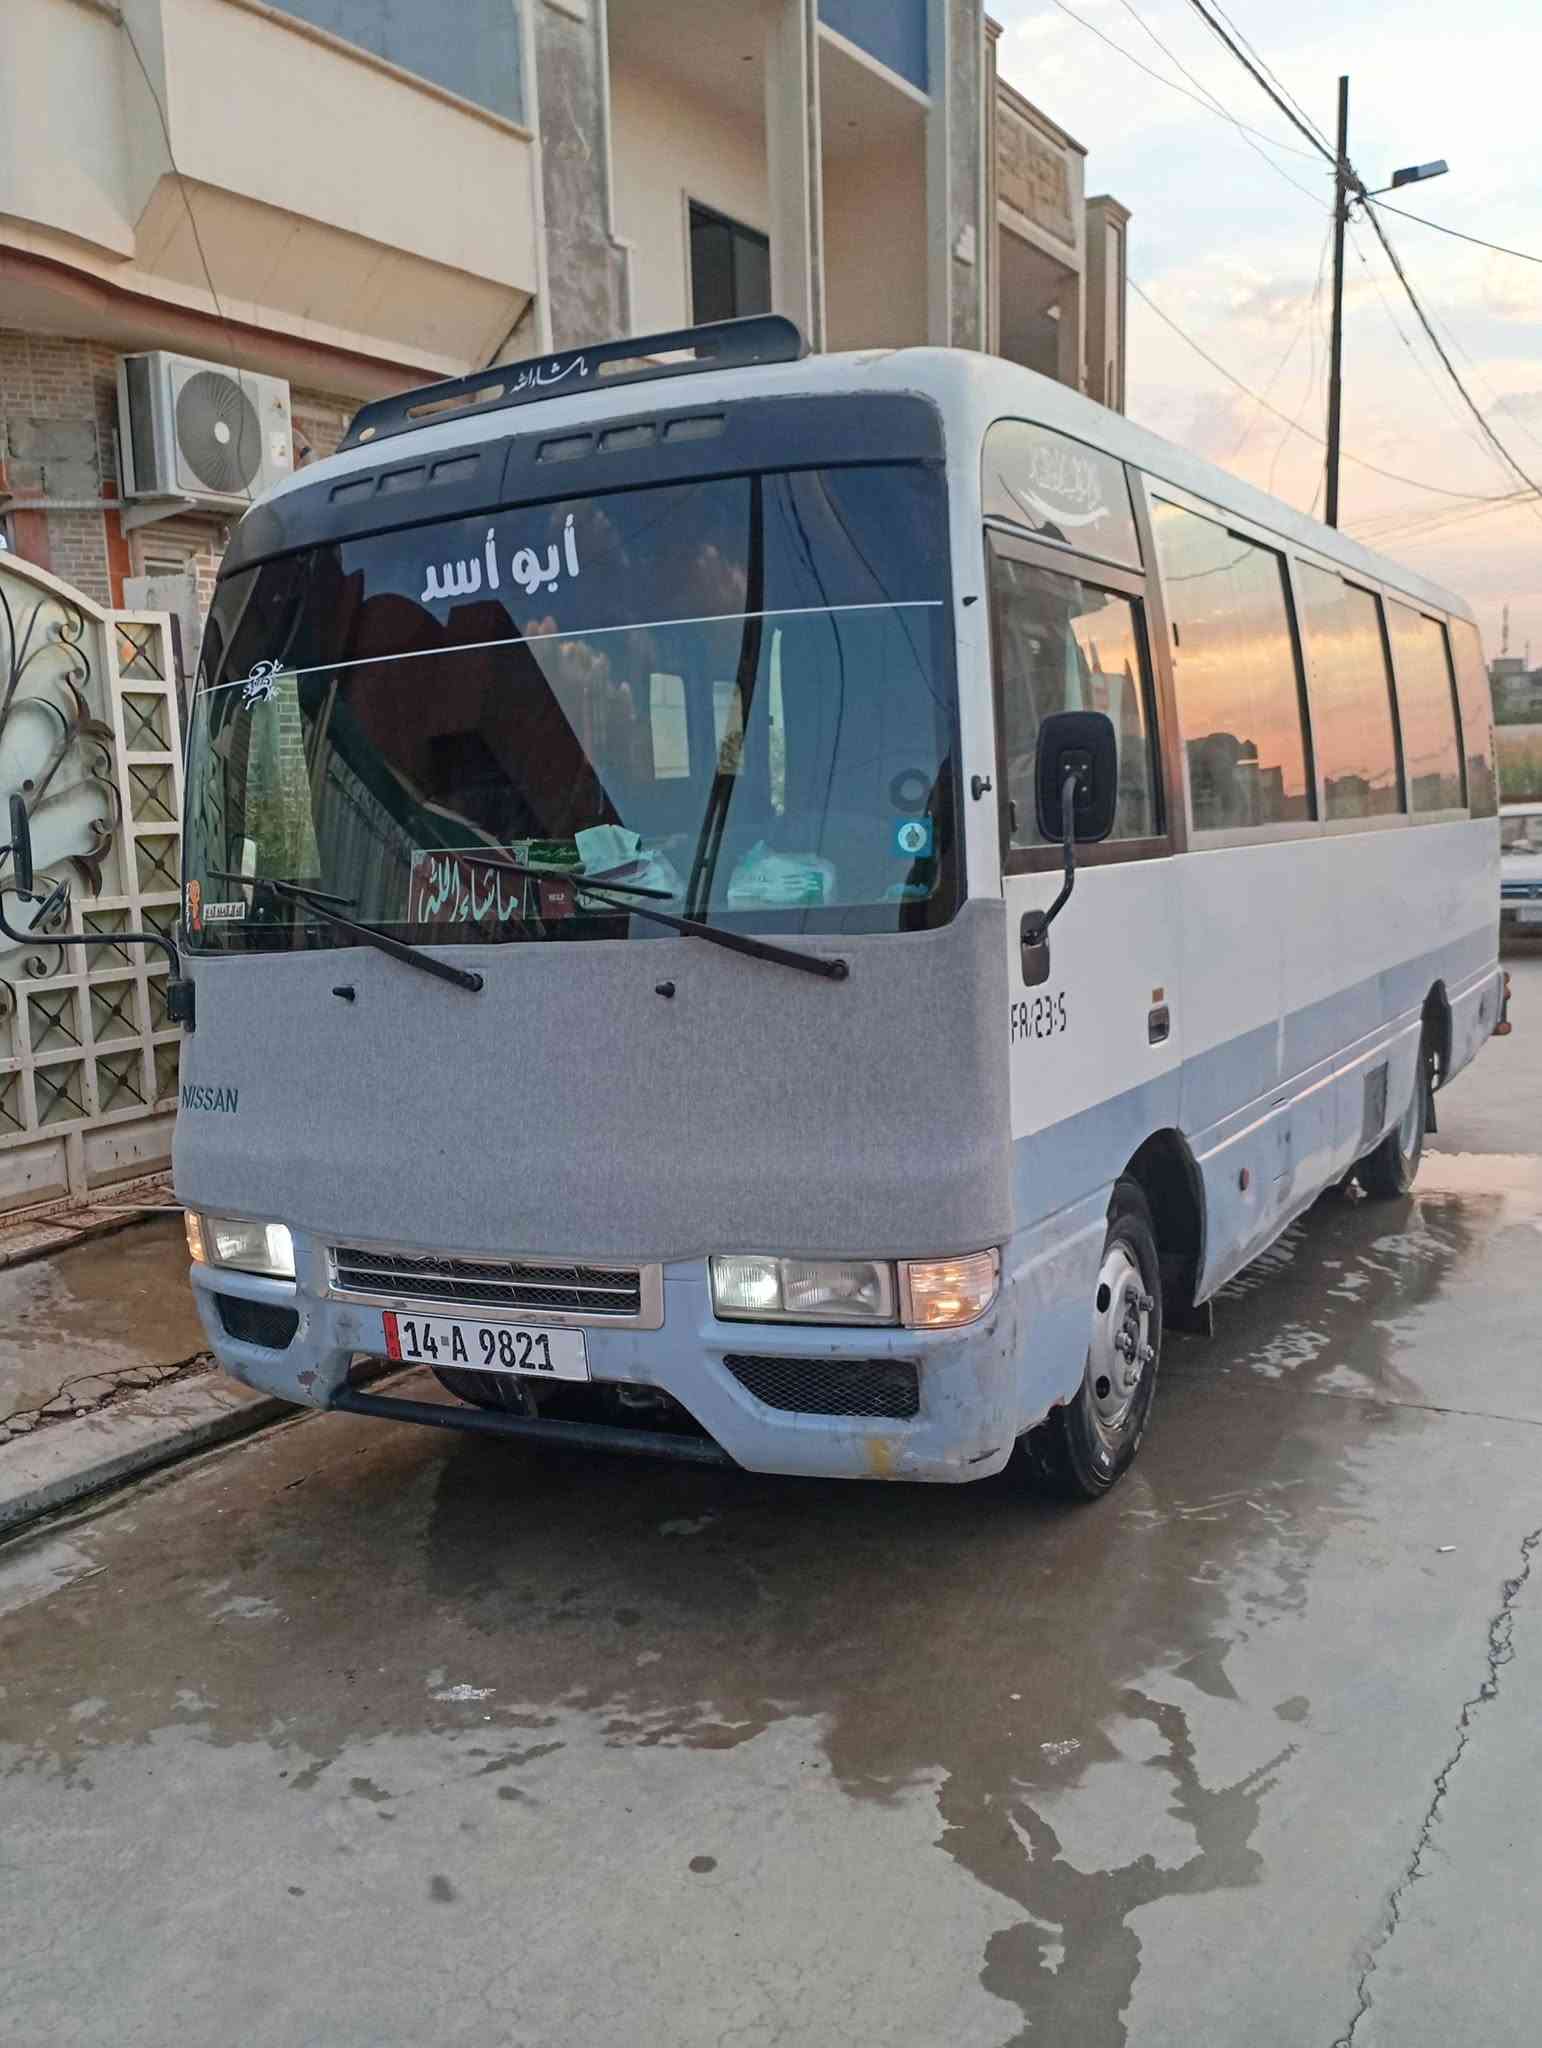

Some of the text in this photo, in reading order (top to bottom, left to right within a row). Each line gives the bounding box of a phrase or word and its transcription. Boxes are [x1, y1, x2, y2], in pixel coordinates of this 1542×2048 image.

[420, 513, 580, 602] أبو أسد
[183, 1085, 239, 1113] NISSAN
[479, 1328, 555, 1372] 9821
